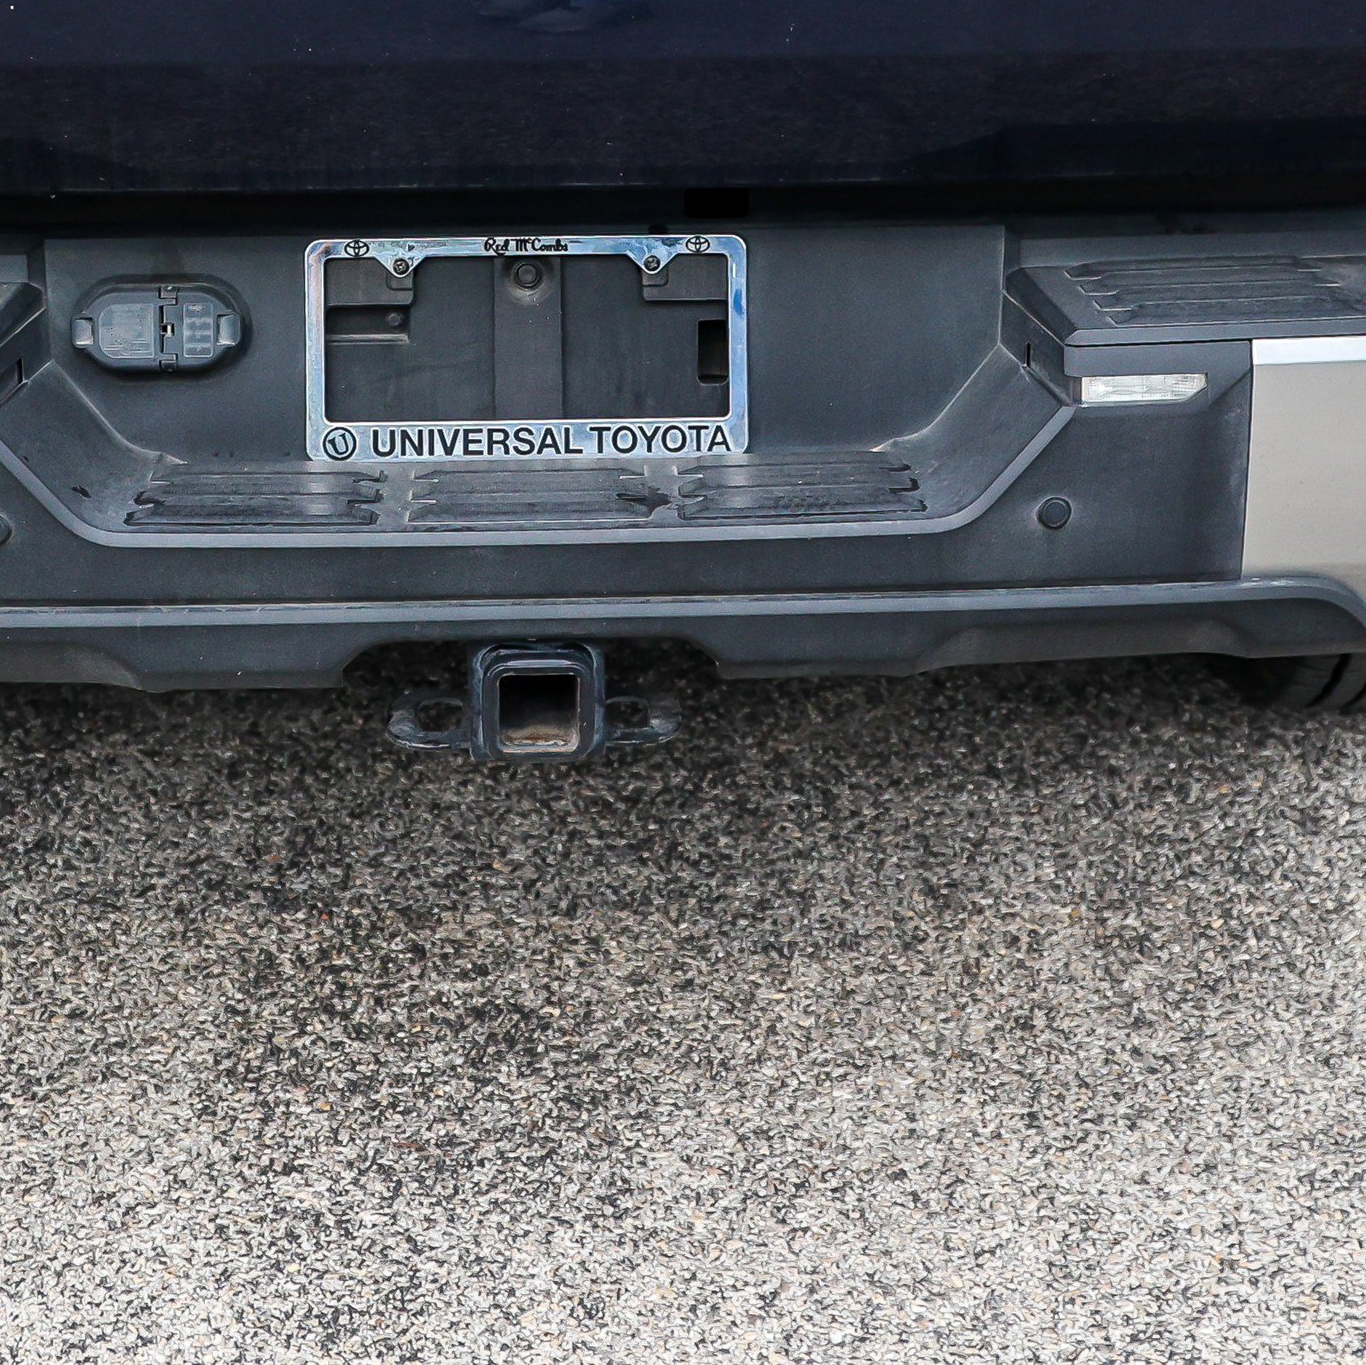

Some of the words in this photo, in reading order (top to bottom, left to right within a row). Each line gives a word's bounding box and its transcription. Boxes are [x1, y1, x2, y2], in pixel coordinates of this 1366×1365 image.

[484, 237, 510, 256] Red
[511, 237, 569, 252] McCombs
[372, 428, 583, 457] UNIVERSAL
[589, 424, 733, 455] TOYOTA
